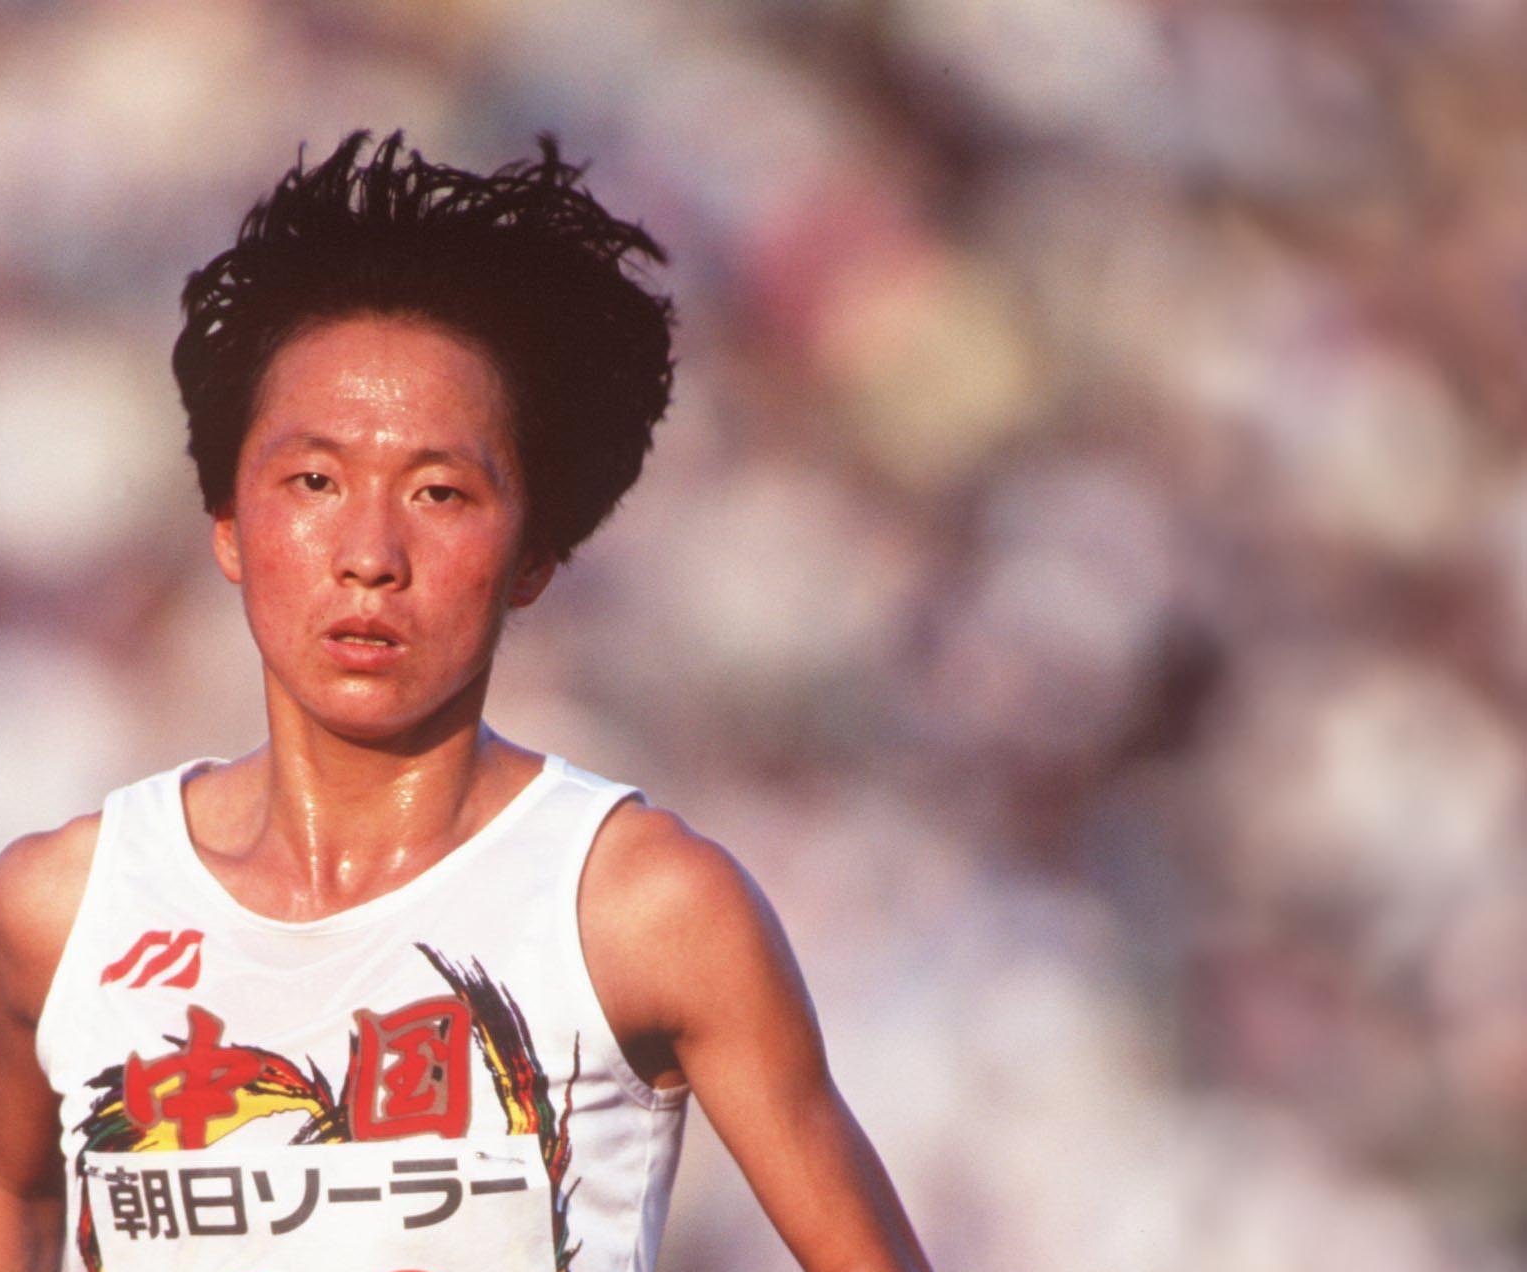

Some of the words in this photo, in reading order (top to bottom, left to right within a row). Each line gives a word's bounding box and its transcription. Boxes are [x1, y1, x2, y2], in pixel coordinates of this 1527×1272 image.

[123, 994, 472, 1149] 中国
[105, 1158, 528, 1240] 朝日ソーラー
